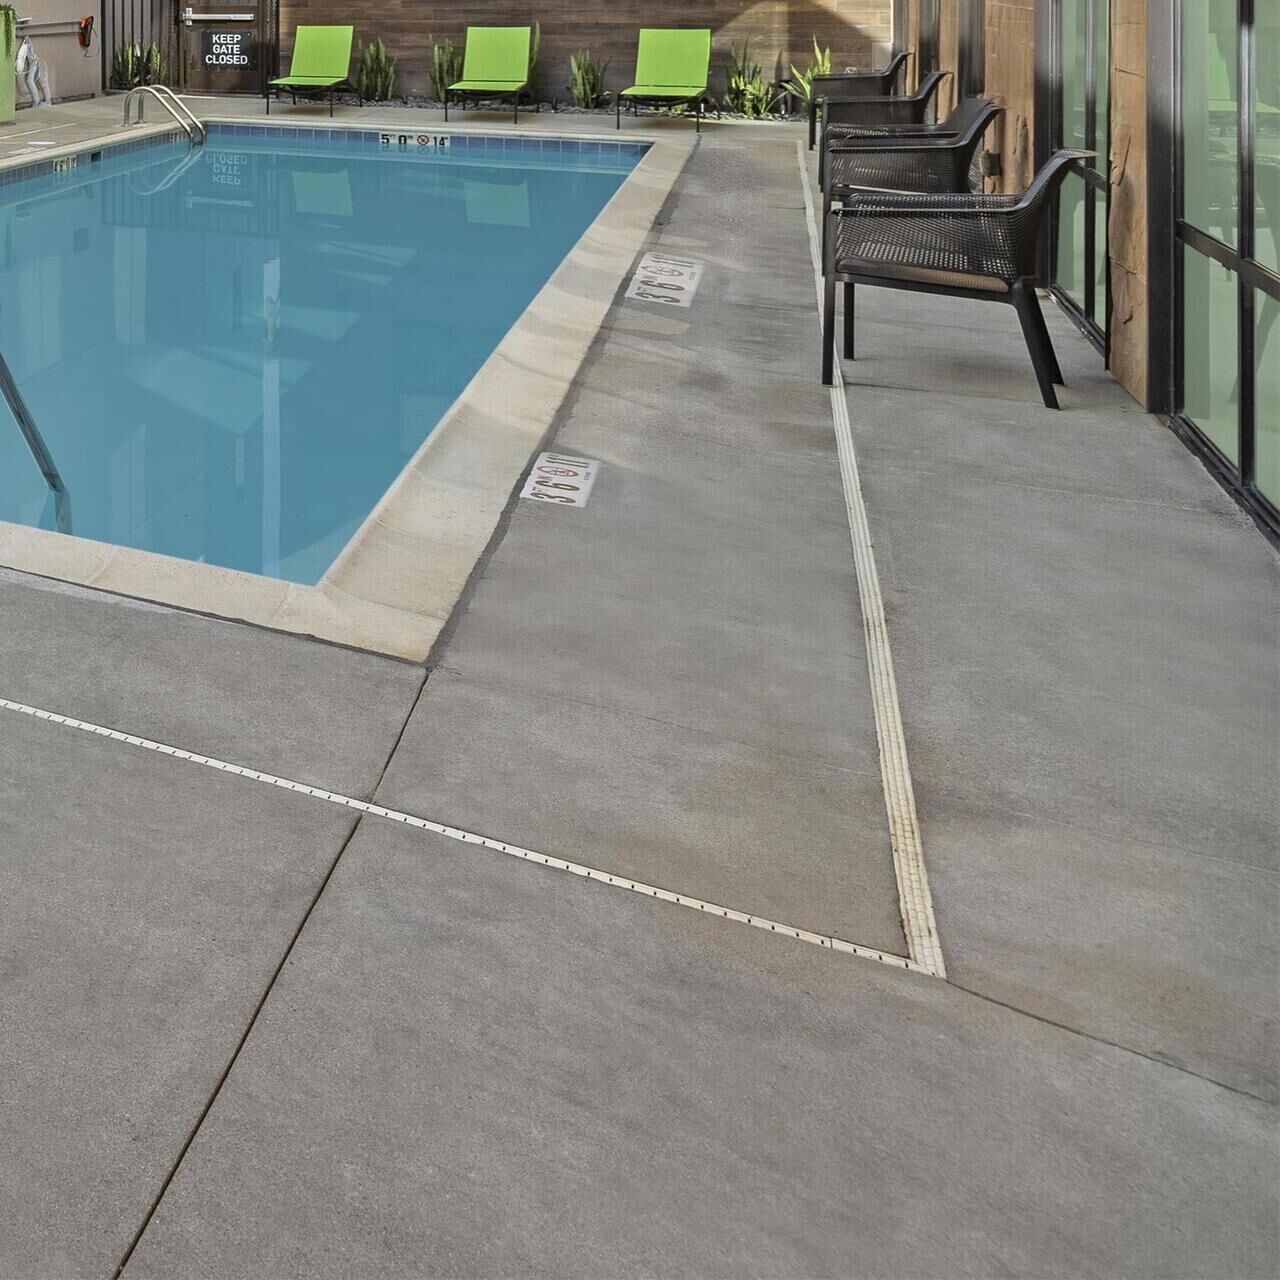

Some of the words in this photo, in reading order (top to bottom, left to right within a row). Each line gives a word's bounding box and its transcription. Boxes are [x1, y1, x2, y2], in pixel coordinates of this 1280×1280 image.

[212, 34, 241, 43] KEEP
[212, 44, 241, 54] GATE
[205, 54, 248, 64] CLOSED
[381, 134, 390, 144] 5
[640, 280, 685, 291] 6
[635, 292, 681, 303] 3
[535, 480, 580, 491] 6
[530, 492, 576, 504] 3
